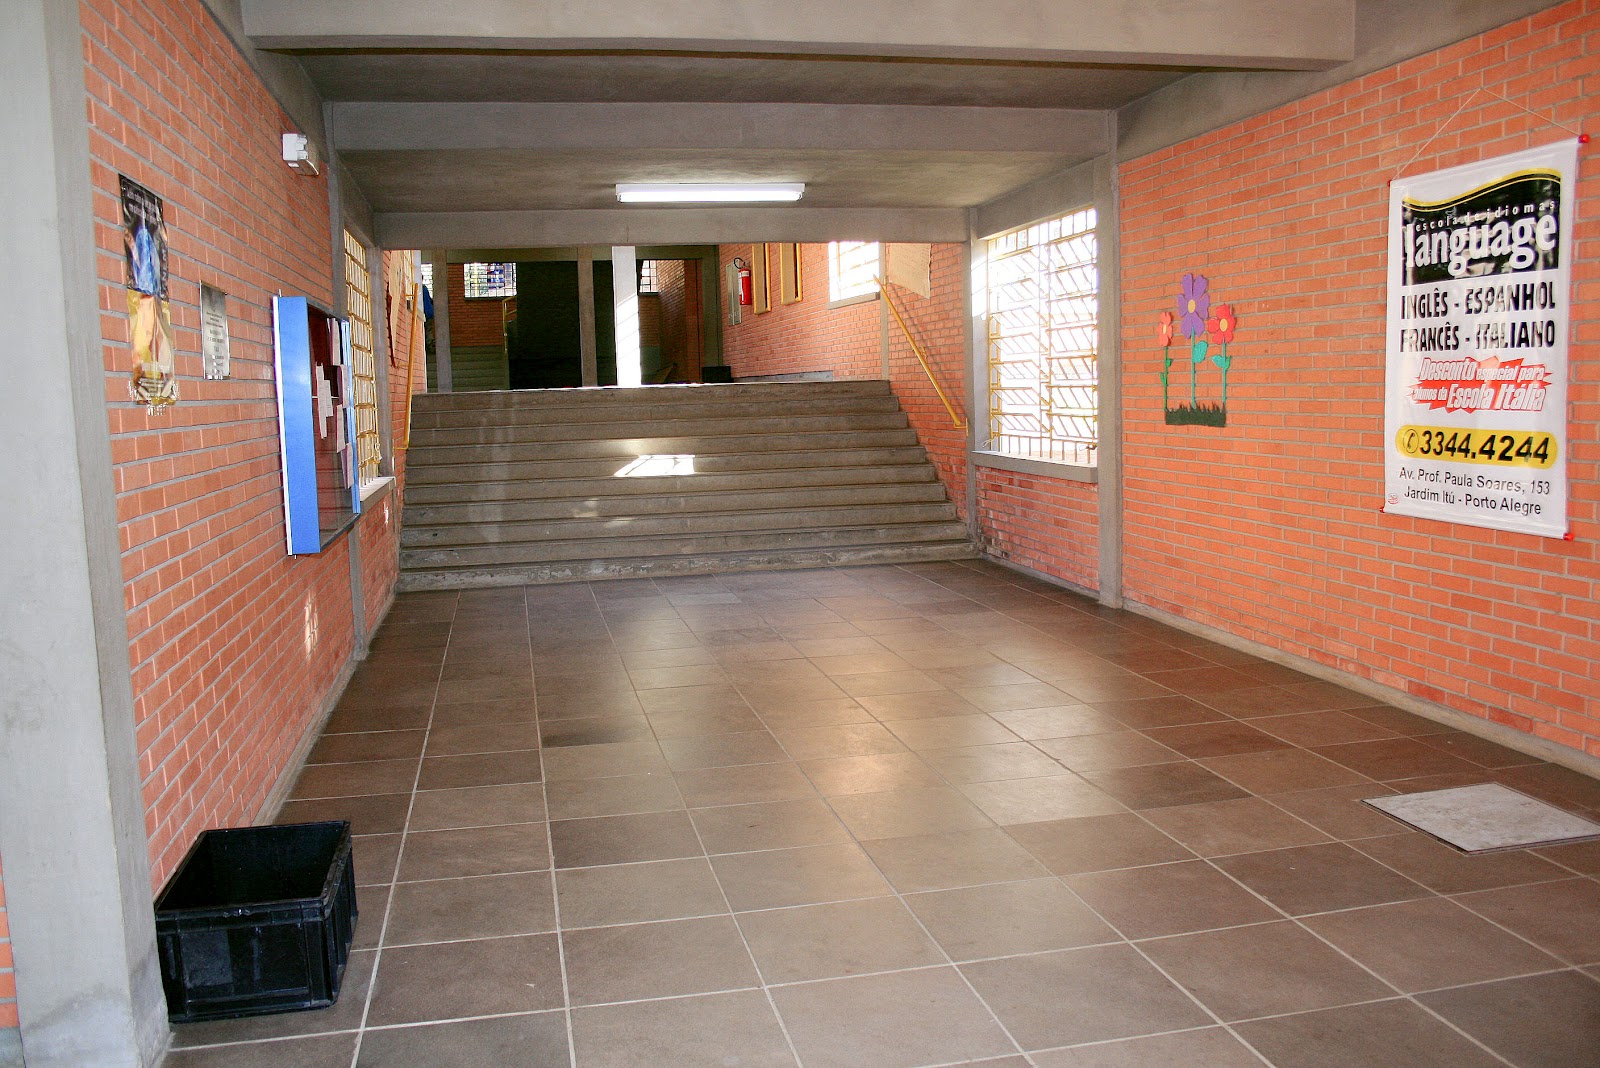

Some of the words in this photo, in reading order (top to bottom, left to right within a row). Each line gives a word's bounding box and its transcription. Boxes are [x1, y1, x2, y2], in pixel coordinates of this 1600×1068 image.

[1406, 214, 1557, 277] language
[1401, 287, 1448, 320] INGLÊS
[1465, 281, 1556, 315] ESPANHOL
[1400, 322, 1459, 353] FRANCÊS
[1476, 320, 1555, 350] ITALIANO
[1420, 357, 1477, 381] Desconto
[1476, 365, 1518, 381] especial
[1516, 366, 1545, 383] para
[1438, 386, 1448, 401] da
[1446, 383, 1495, 409] Escola
[1497, 382, 1547, 411] Itália
[1419, 430, 1549, 465] 3344.4244
[1399, 467, 1415, 480] Av.
[1418, 468, 1442, 483] Prof.
[1444, 471, 1473, 488] Paula
[1476, 475, 1525, 495] Soares,
[1530, 480, 1550, 495] 153
[1404, 486, 1439, 503] Jardim
[1442, 490, 1455, 505] Itú
[1465, 493, 1497, 510] Porto
[1499, 497, 1542, 517] Alegre
